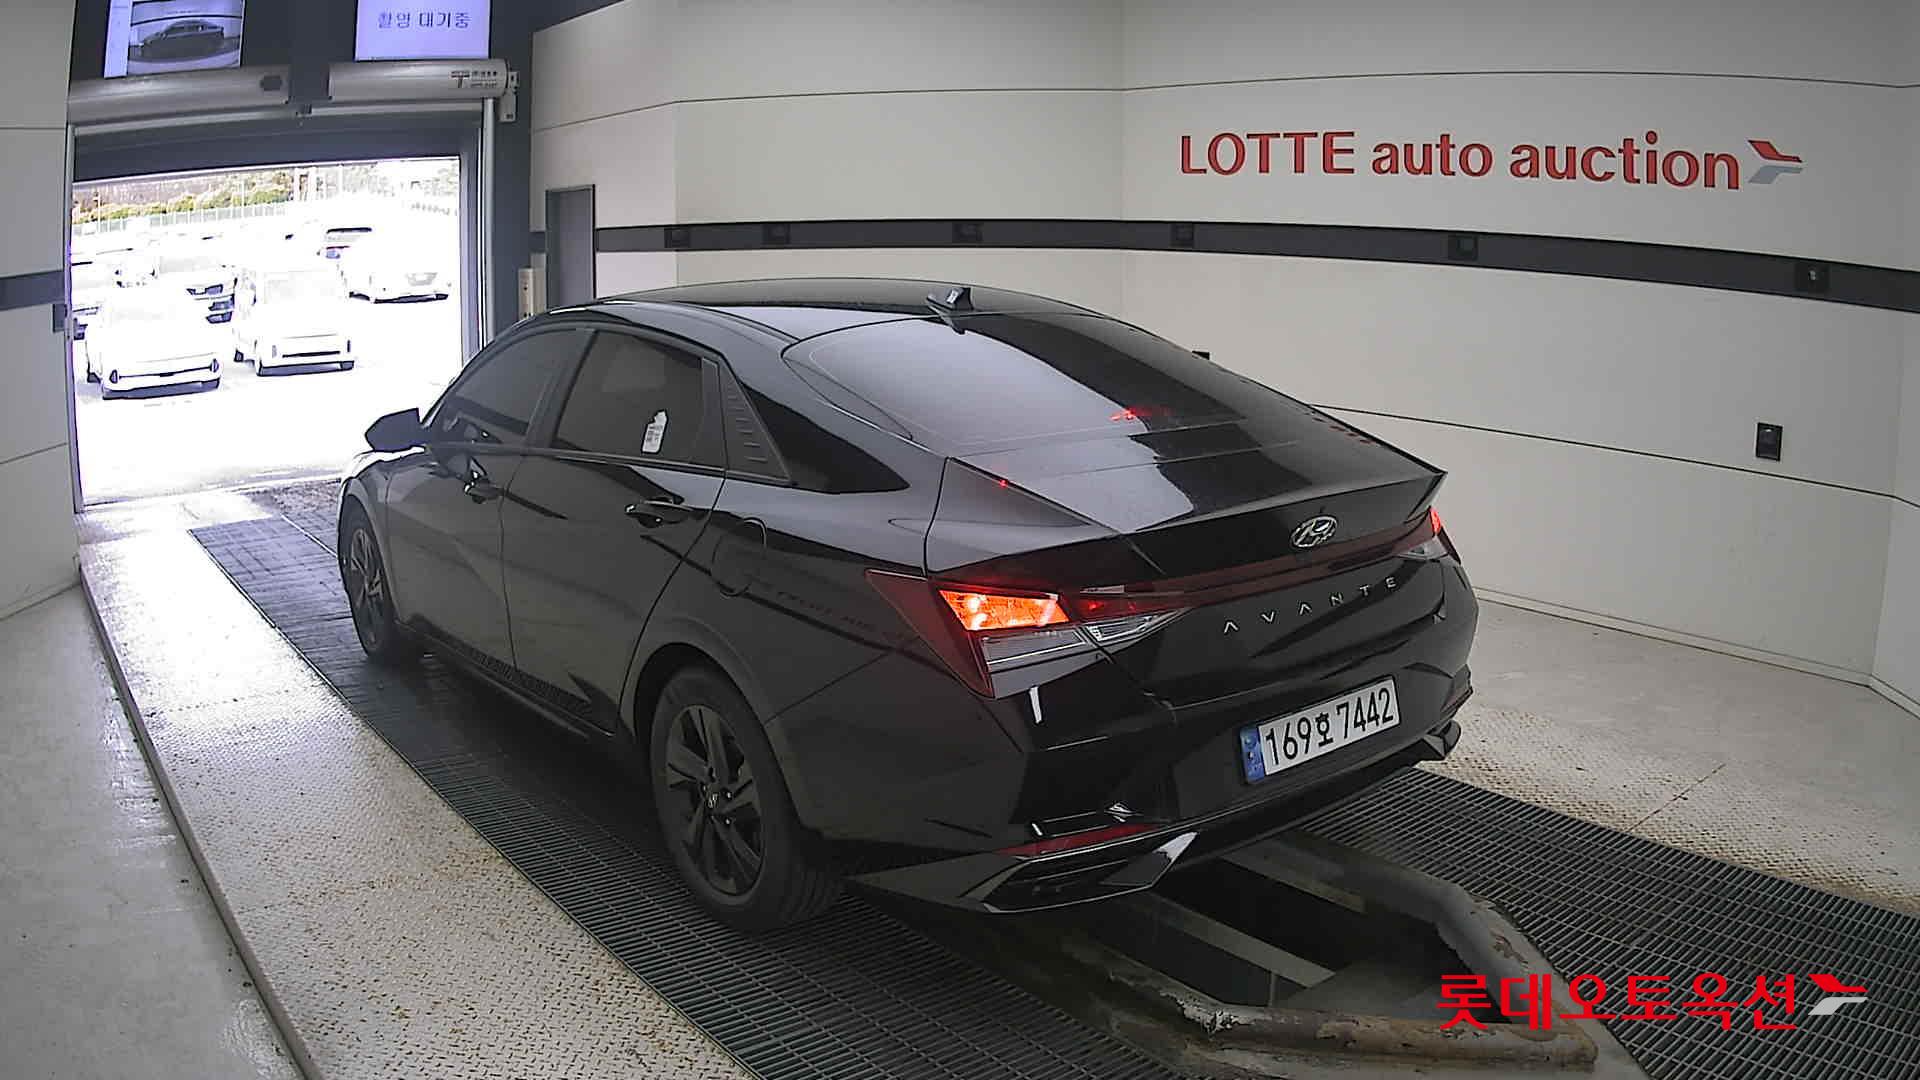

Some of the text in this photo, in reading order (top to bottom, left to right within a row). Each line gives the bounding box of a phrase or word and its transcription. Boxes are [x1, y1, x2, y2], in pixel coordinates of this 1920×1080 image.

[419, 12, 472, 29] 대기중
[1181, 130, 1741, 190] LOTTE auto auction
[1223, 576, 1397, 635] AVANTE
[1264, 687, 1395, 766] 169호 7442
